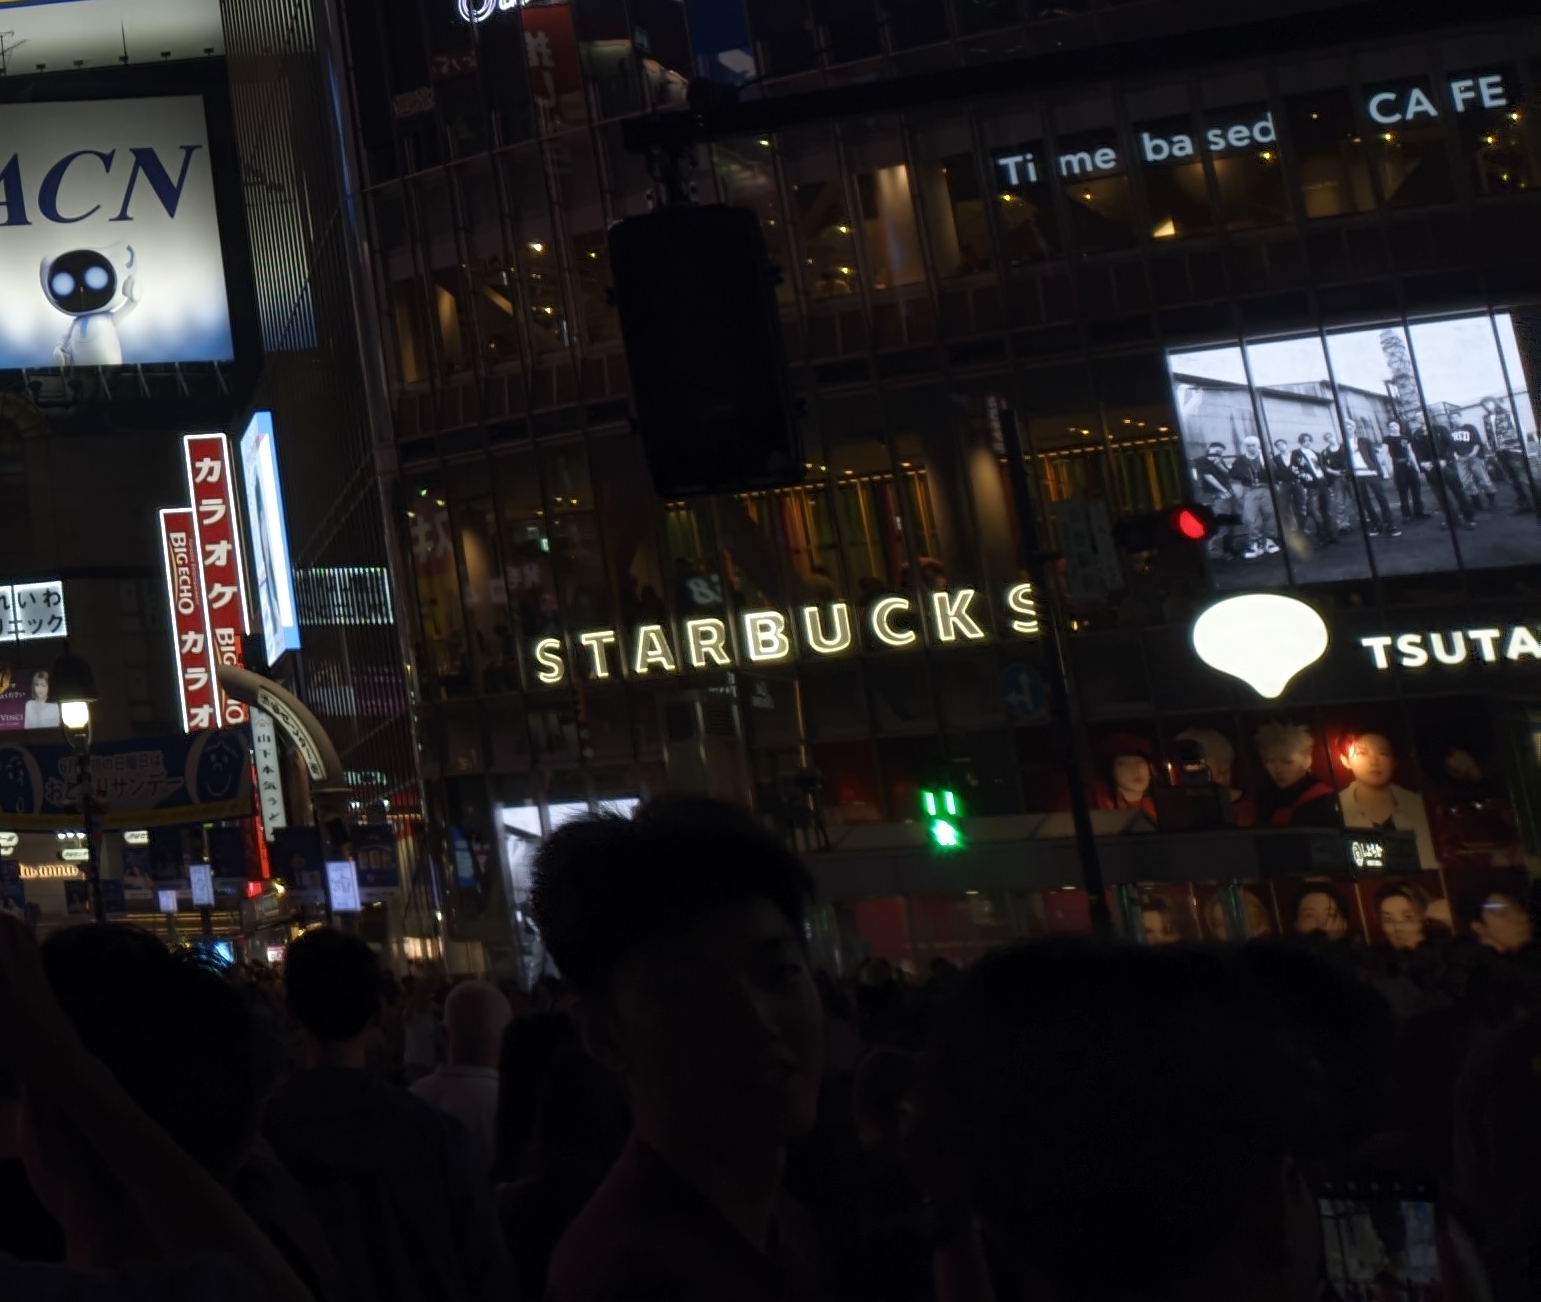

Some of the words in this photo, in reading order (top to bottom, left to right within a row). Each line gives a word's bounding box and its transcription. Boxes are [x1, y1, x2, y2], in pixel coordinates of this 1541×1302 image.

[194, 456, 240, 611] カラオケ
[181, 630, 214, 729] カラオ
[533, 582, 1041, 685] STARBUCKS
